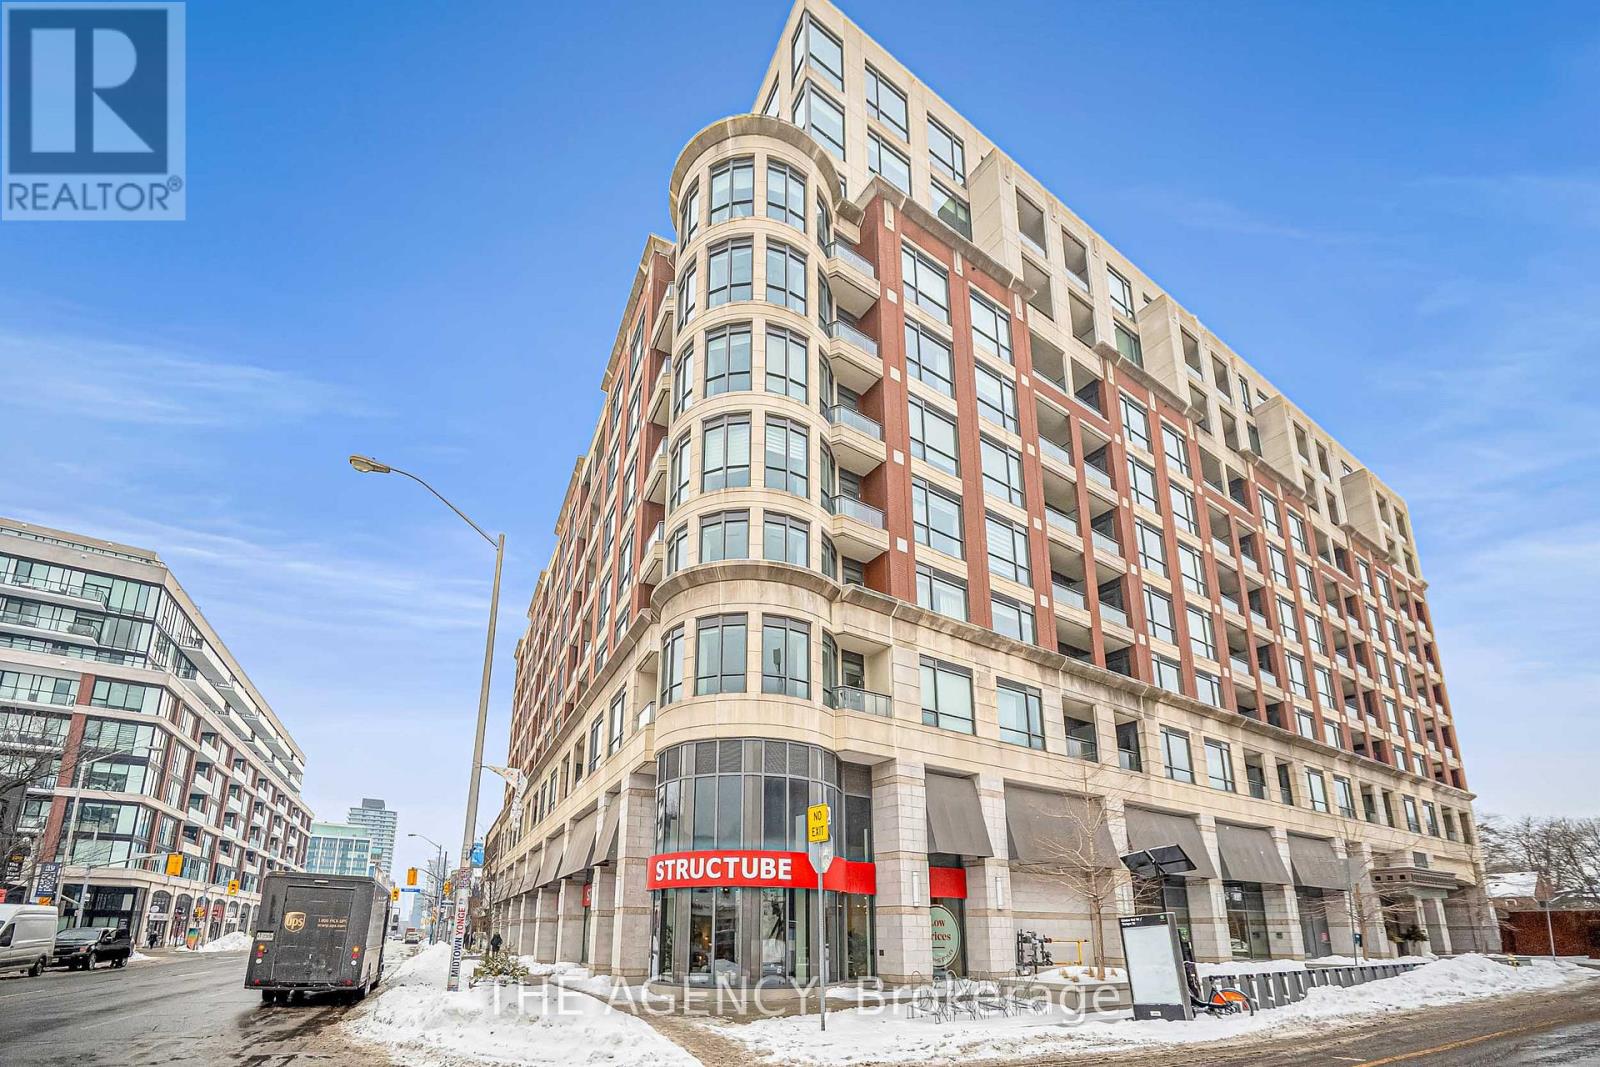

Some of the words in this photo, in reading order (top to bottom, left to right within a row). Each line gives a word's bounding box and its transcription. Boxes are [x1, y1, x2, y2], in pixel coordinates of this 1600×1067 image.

[813, 810, 823, 822] NO
[811, 825, 825, 837] EXIT
[655, 856, 793, 882] STRUCTUBE
[286, 917, 304, 930] ups
[455, 908, 466, 936] YONGE
[931, 919, 945, 927] ow
[931, 931, 952, 941] rices
[451, 937, 463, 977] MIDTOWN
